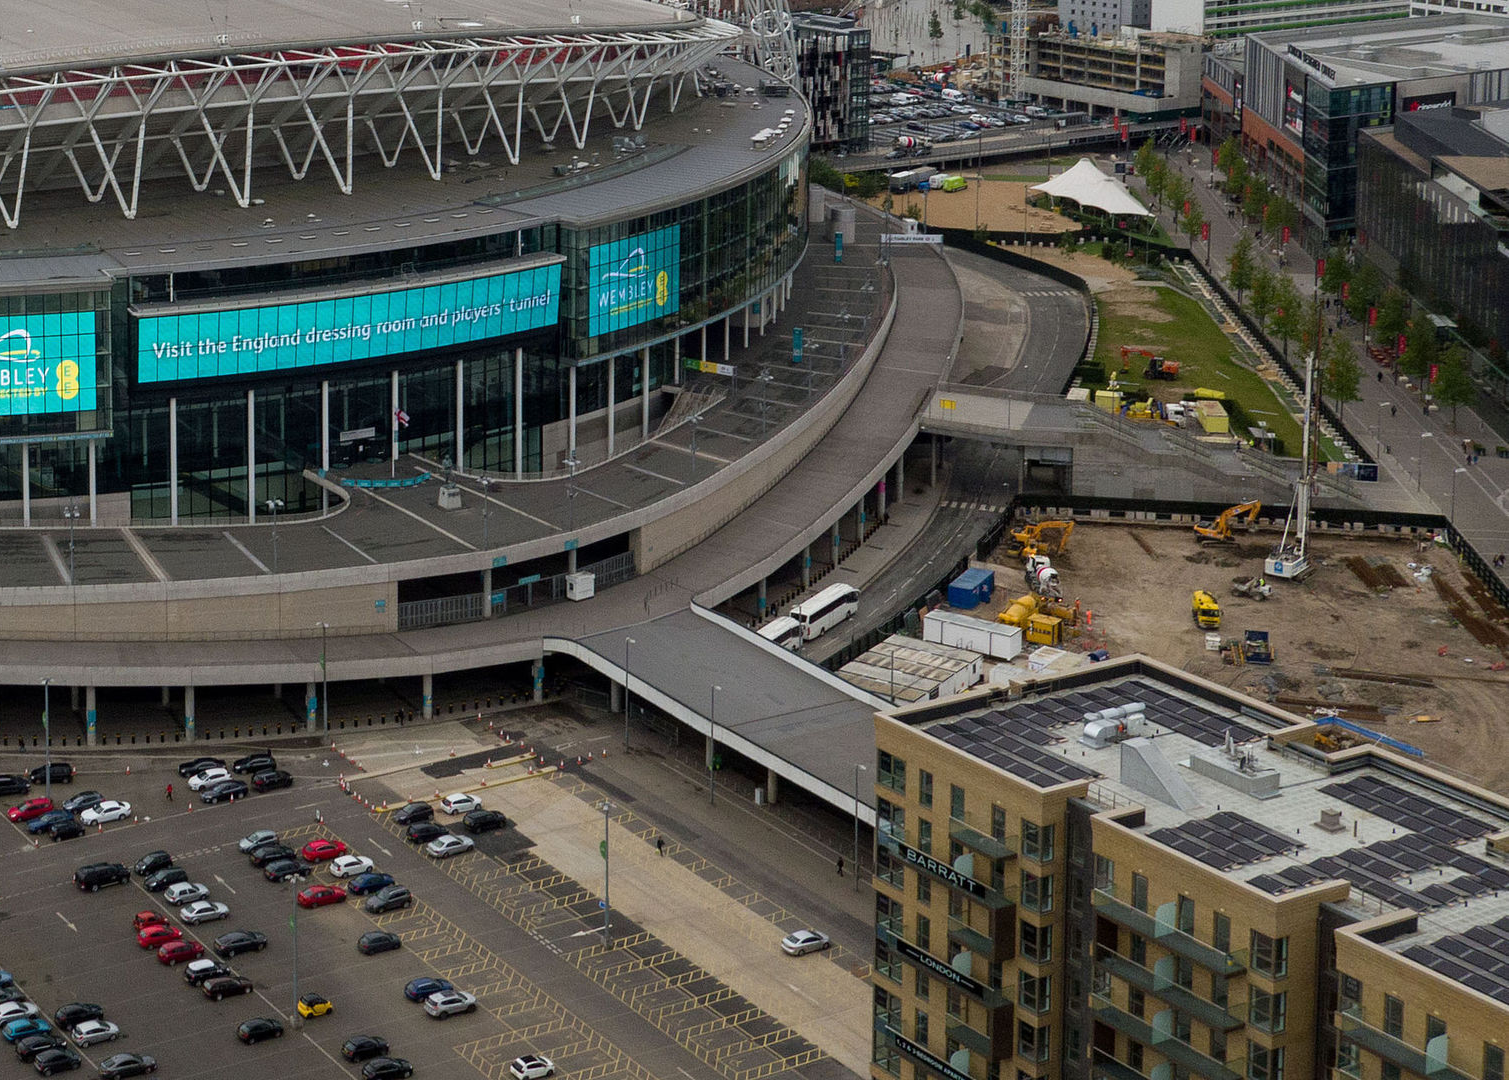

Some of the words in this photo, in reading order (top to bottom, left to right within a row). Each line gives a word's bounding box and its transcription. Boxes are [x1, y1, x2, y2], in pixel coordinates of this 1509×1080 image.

[597, 279, 654, 307] WEMBLEY
[152, 340, 192, 359] Visit
[198, 338, 227, 355] the
[232, 329, 300, 354] England
[305, 322, 371, 344] dressing
[376, 317, 415, 334] room
[420, 308, 448, 327] and
[509, 290, 551, 312] tunnel
[35, 386, 48, 397] BY
[907, 849, 976, 892] BARRATT
[920, 954, 960, 982] LONDON
